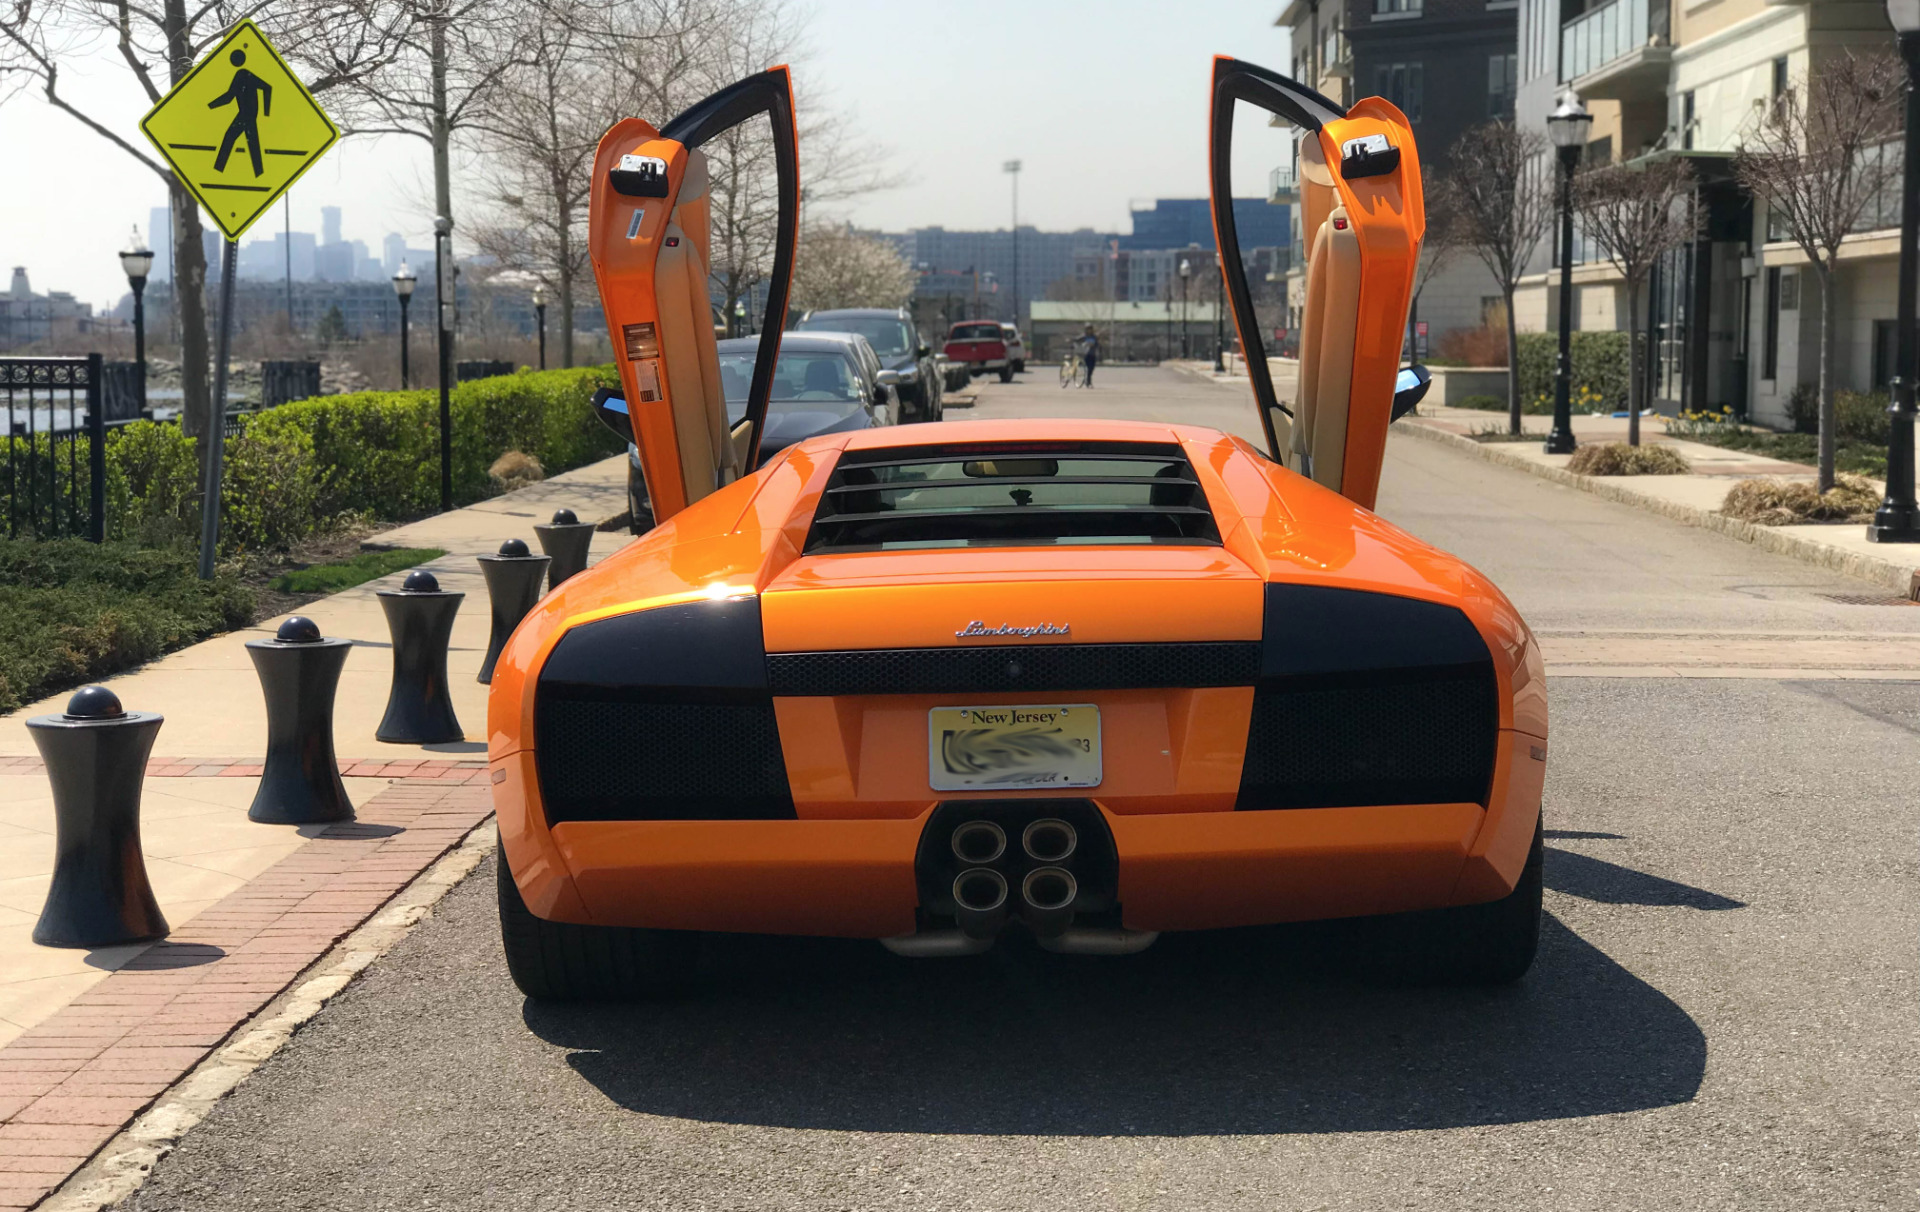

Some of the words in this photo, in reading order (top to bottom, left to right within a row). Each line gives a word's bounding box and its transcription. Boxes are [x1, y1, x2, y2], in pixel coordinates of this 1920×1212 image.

[955, 621, 1069, 638] Lamborghini
[972, 711, 1008, 724] New
[1009, 710, 1057, 726] Jersey
